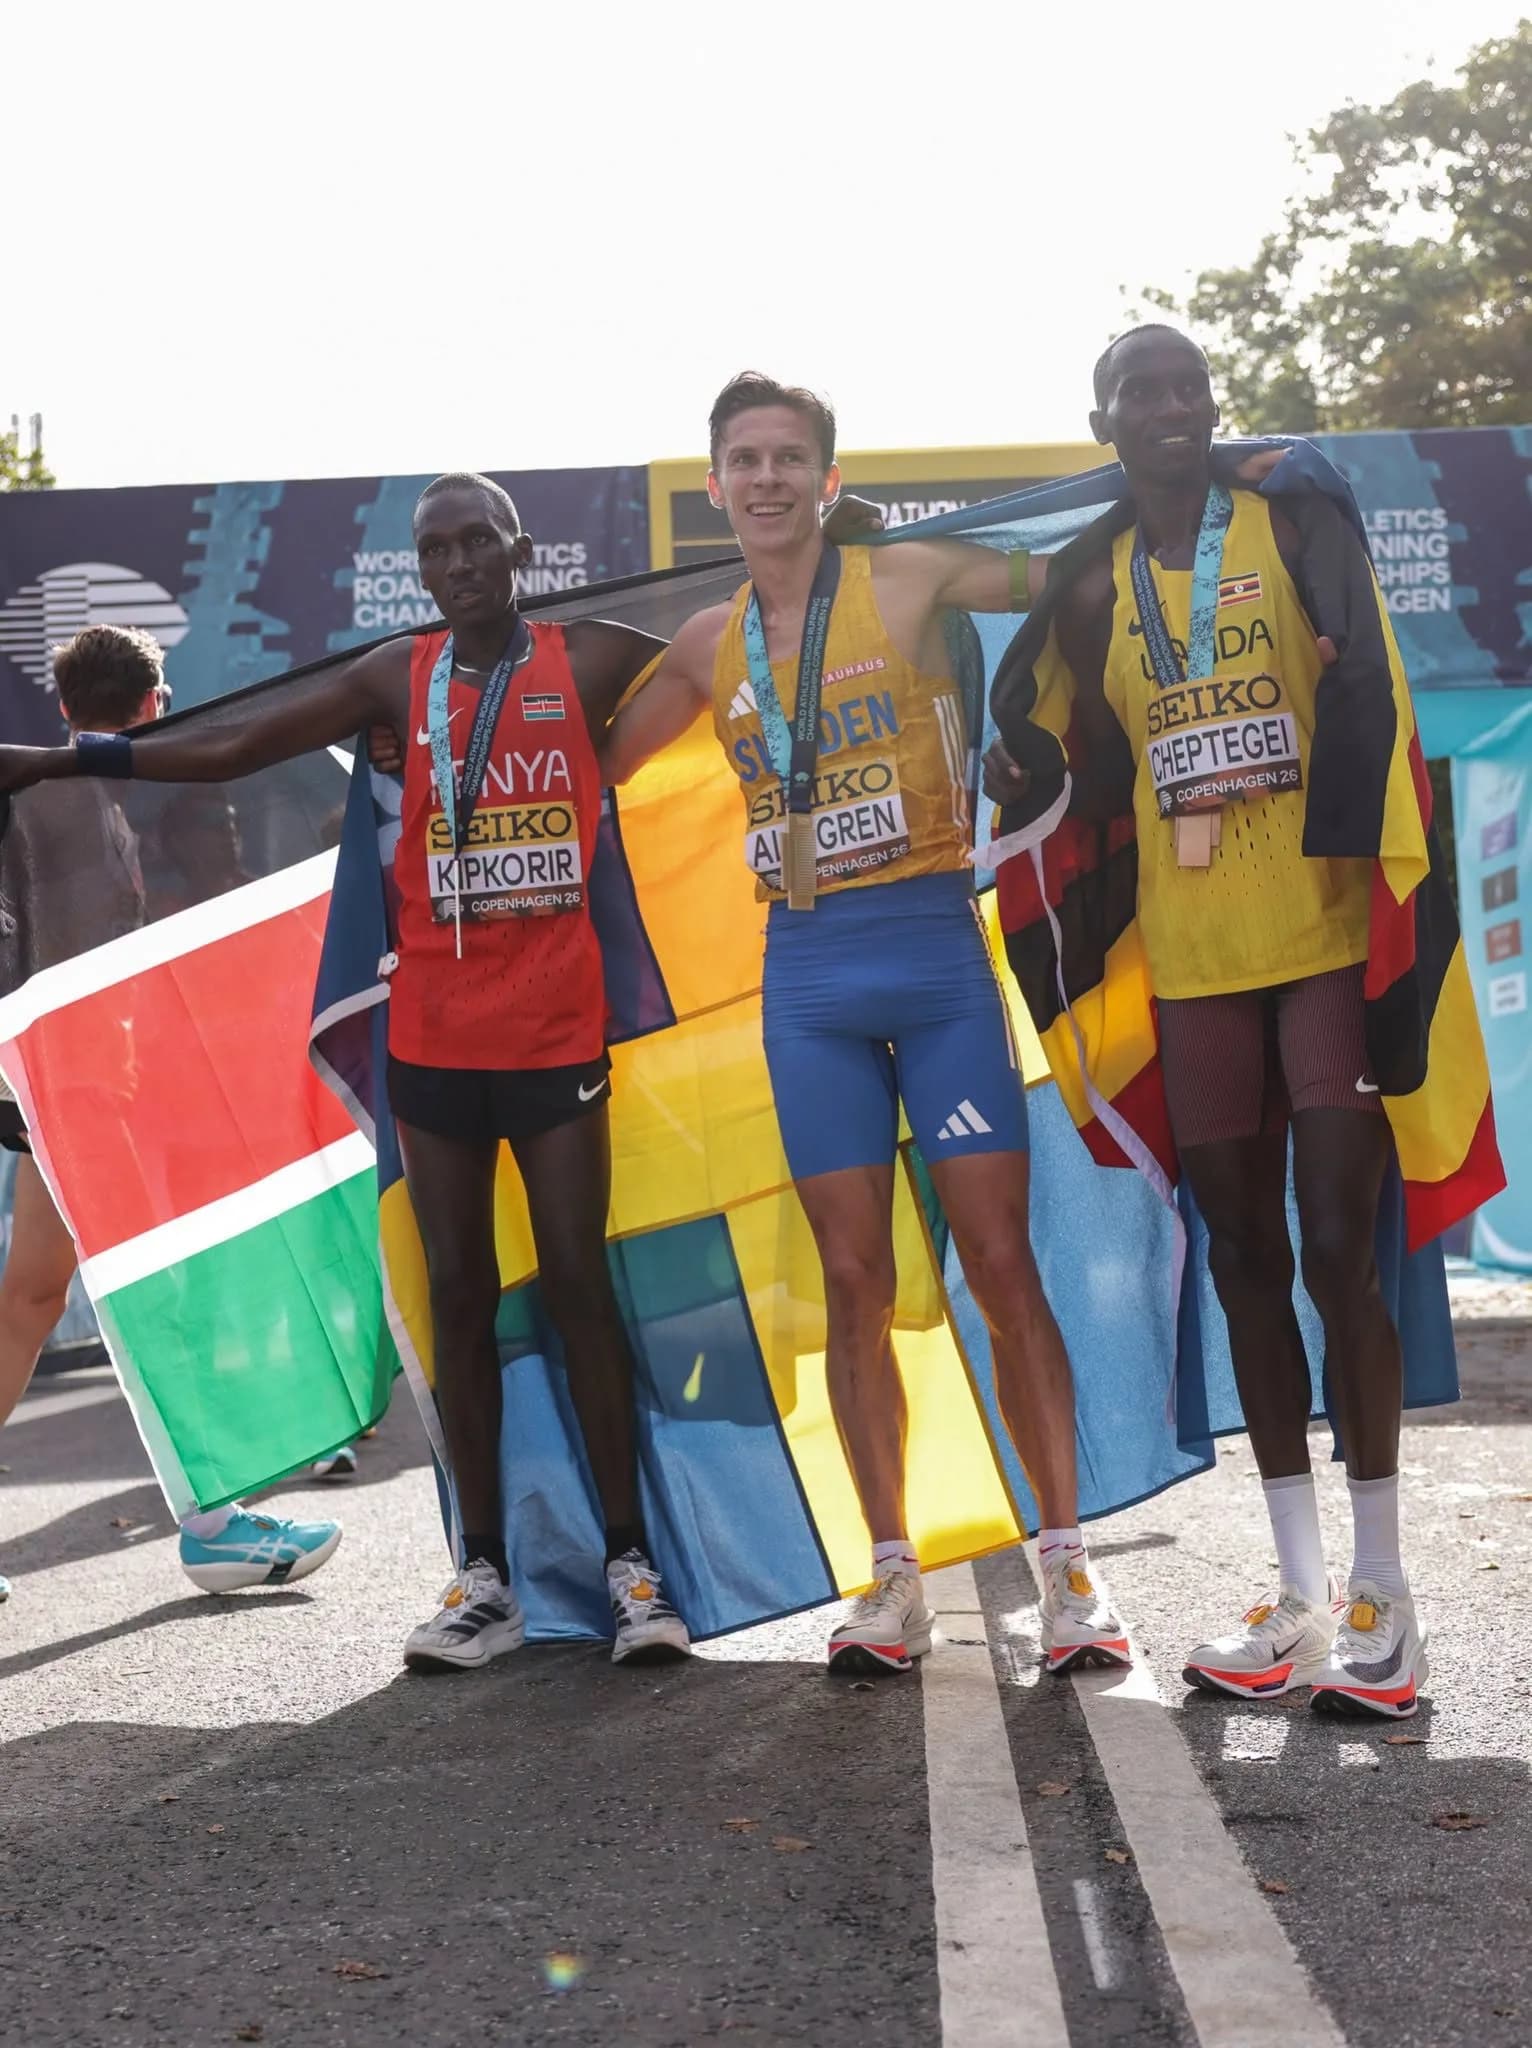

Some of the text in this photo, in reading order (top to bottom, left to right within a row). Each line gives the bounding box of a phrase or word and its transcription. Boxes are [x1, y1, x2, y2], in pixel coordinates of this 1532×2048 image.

[797, 597, 820, 741] WORLD ATHLETICS ROAD RUNNING
[807, 670, 819, 742] CHAMPIONSHIPS
[813, 609, 827, 668] COPENHAGEN
[821, 658, 885, 686] AUHAUS
[469, 728, 491, 796] CHAMPIONSHIPS
[487, 673, 508, 727] COPENHAGEN
[734, 691, 899, 783] SDEN
[1147, 675, 1281, 737] SEIKO
[463, 764, 474, 793] WORLD
[469, 720, 484, 763] ATHLETICS
[1151, 719, 1290, 783] CHEPTEGEI
[1176, 769, 1298, 802] COPENHAGEN 26
[430, 806, 572, 849] SEIKO
[437, 848, 574, 892] KIPKORIR
[471, 891, 581, 913] COPENHAGEN 26
